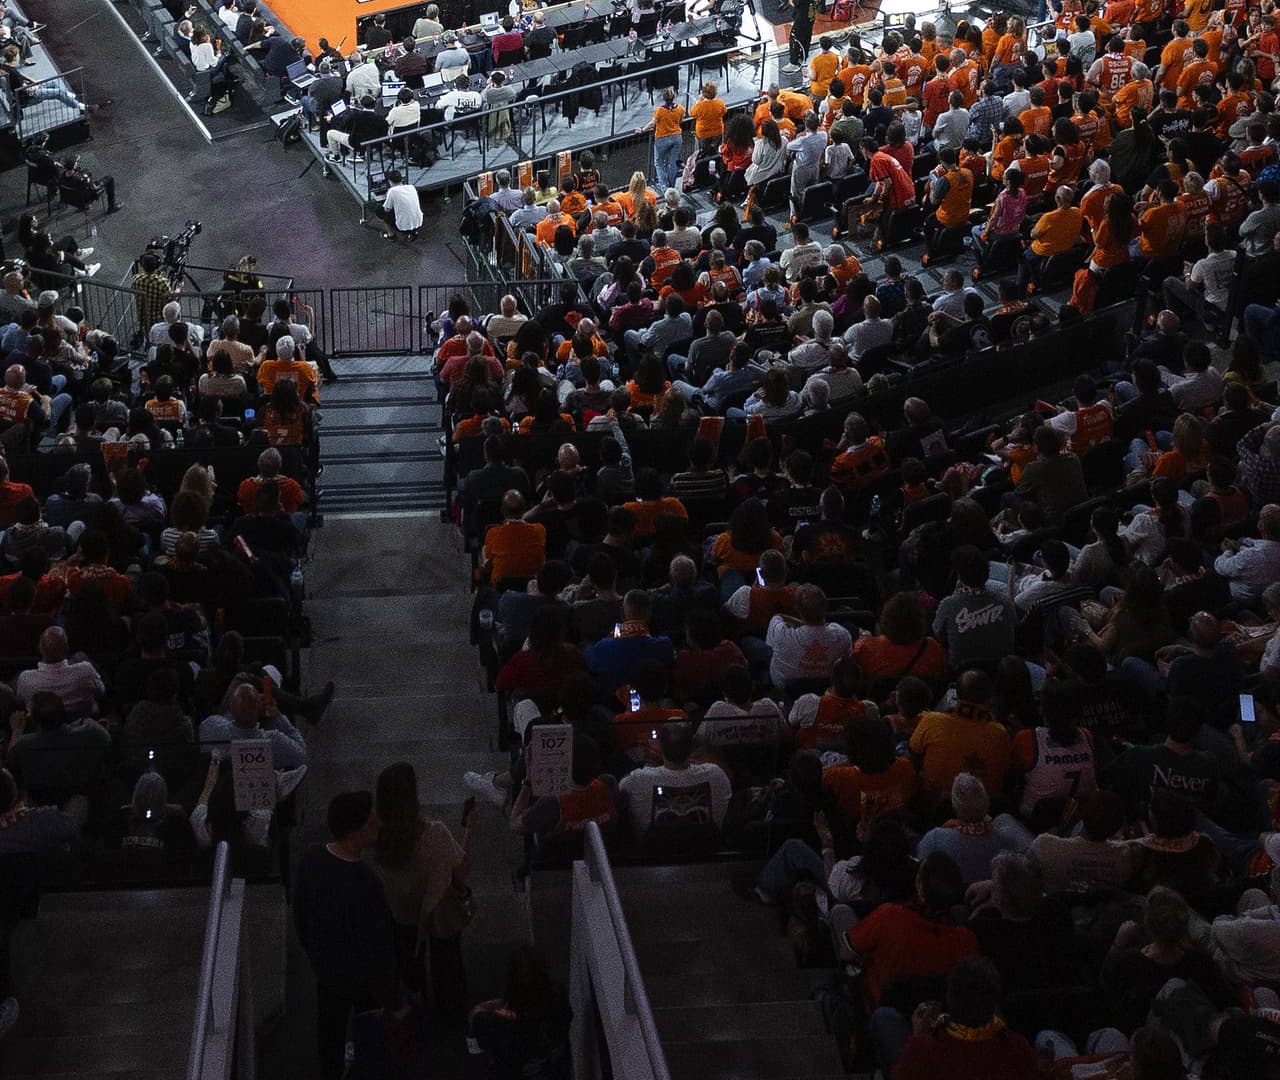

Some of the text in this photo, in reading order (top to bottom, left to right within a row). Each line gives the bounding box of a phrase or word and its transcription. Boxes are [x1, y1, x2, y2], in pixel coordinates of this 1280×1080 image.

[1110, 74, 1126, 90] 86
[541, 737, 566, 750] 107
[238, 752, 266, 764] 106
[1152, 764, 1210, 793] Never
